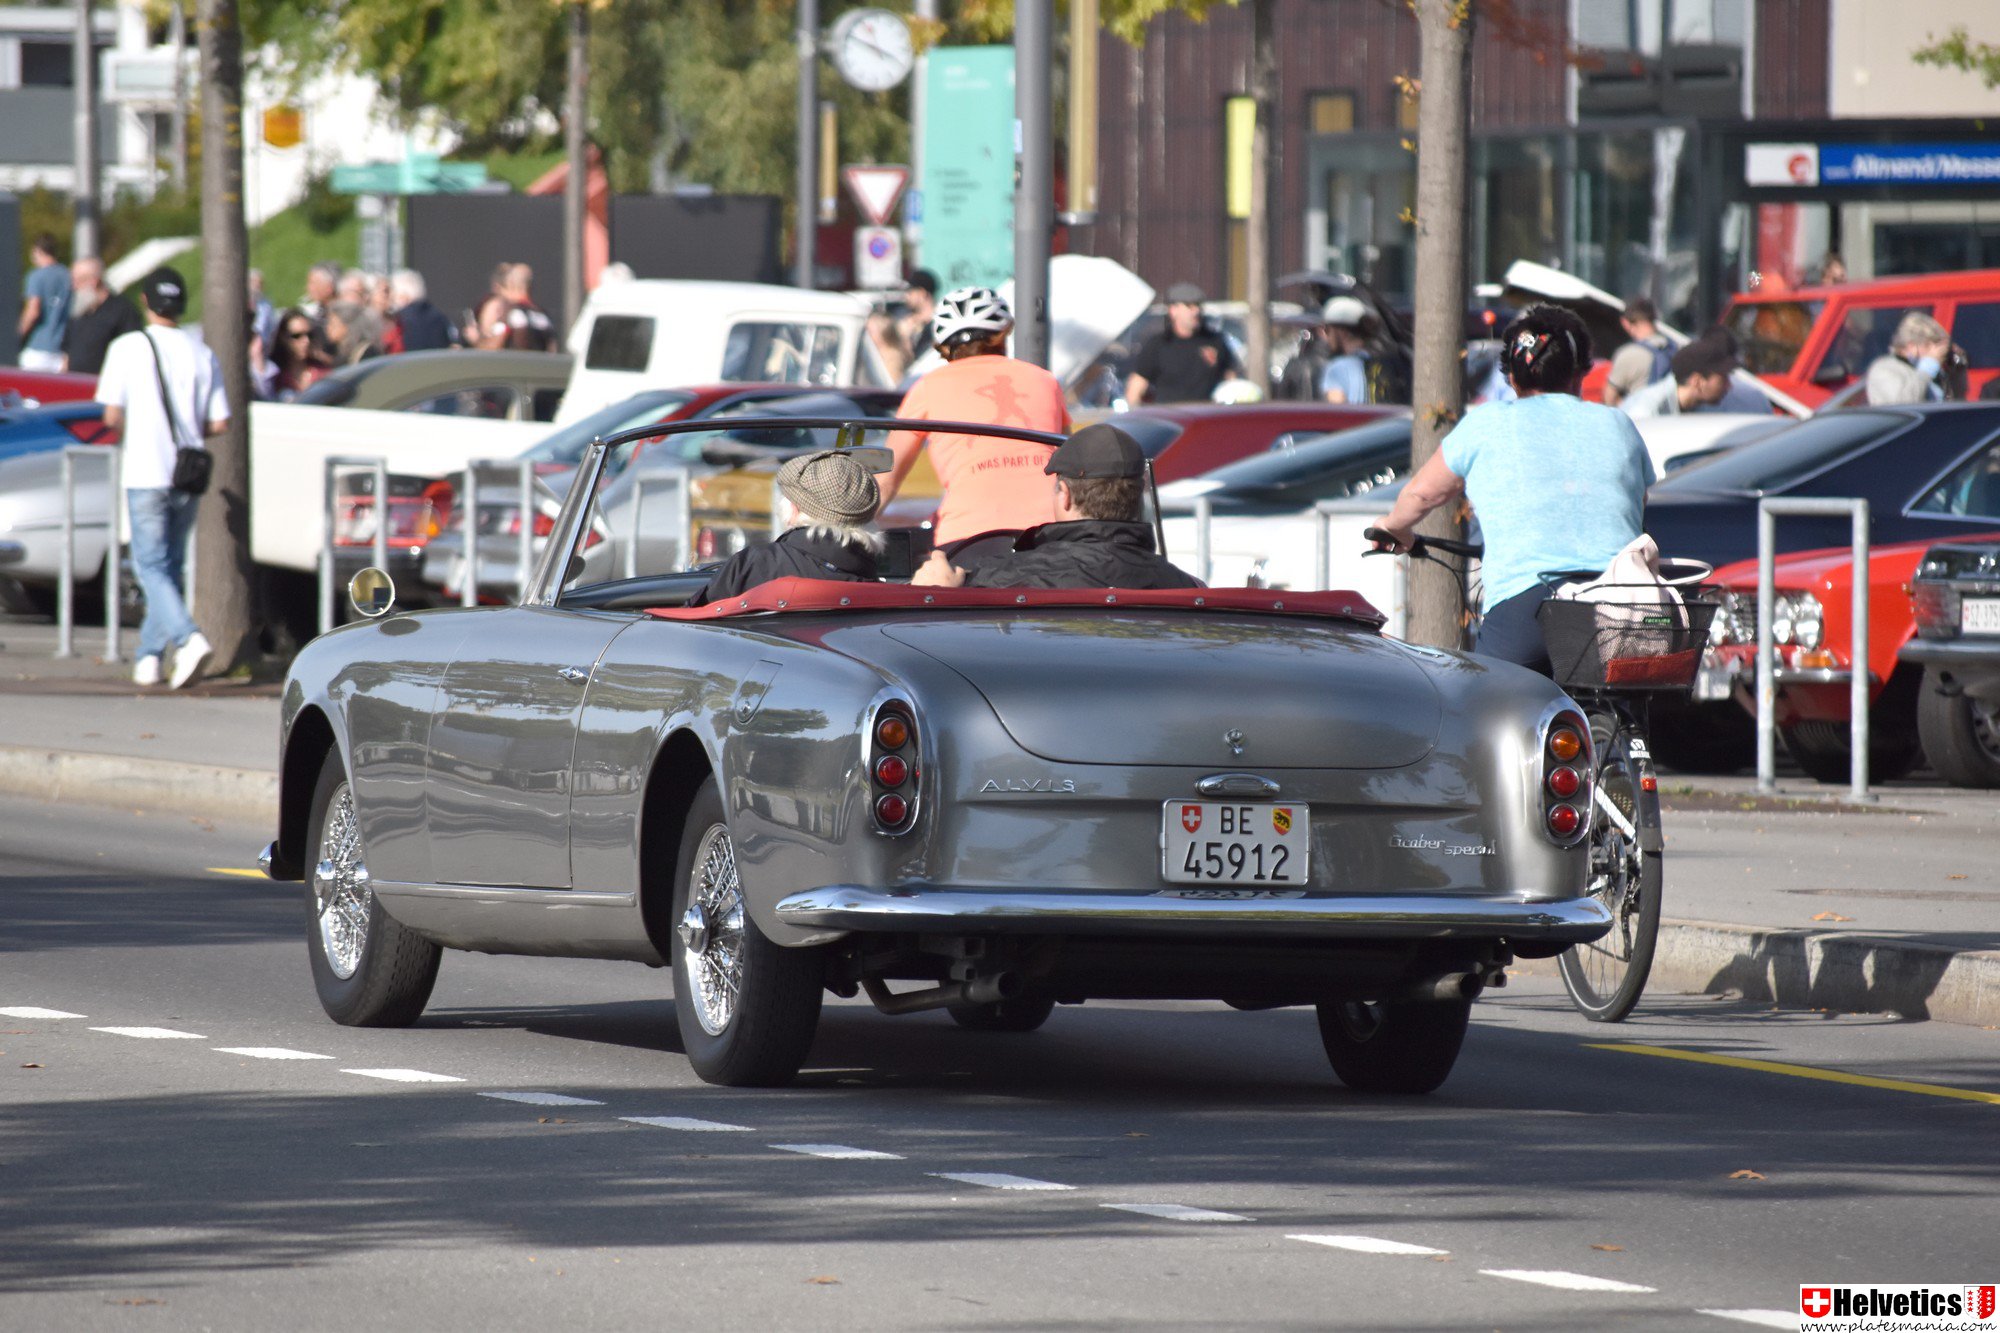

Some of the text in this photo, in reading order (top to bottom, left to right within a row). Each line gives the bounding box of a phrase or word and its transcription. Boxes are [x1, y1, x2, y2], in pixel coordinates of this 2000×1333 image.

[977, 458, 999, 471] WAS
[1003, 455, 1029, 467] PART
[980, 779, 1075, 793] ALVIS
[1220, 806, 1254, 835] BE
[1183, 841, 1290, 881] 45912
